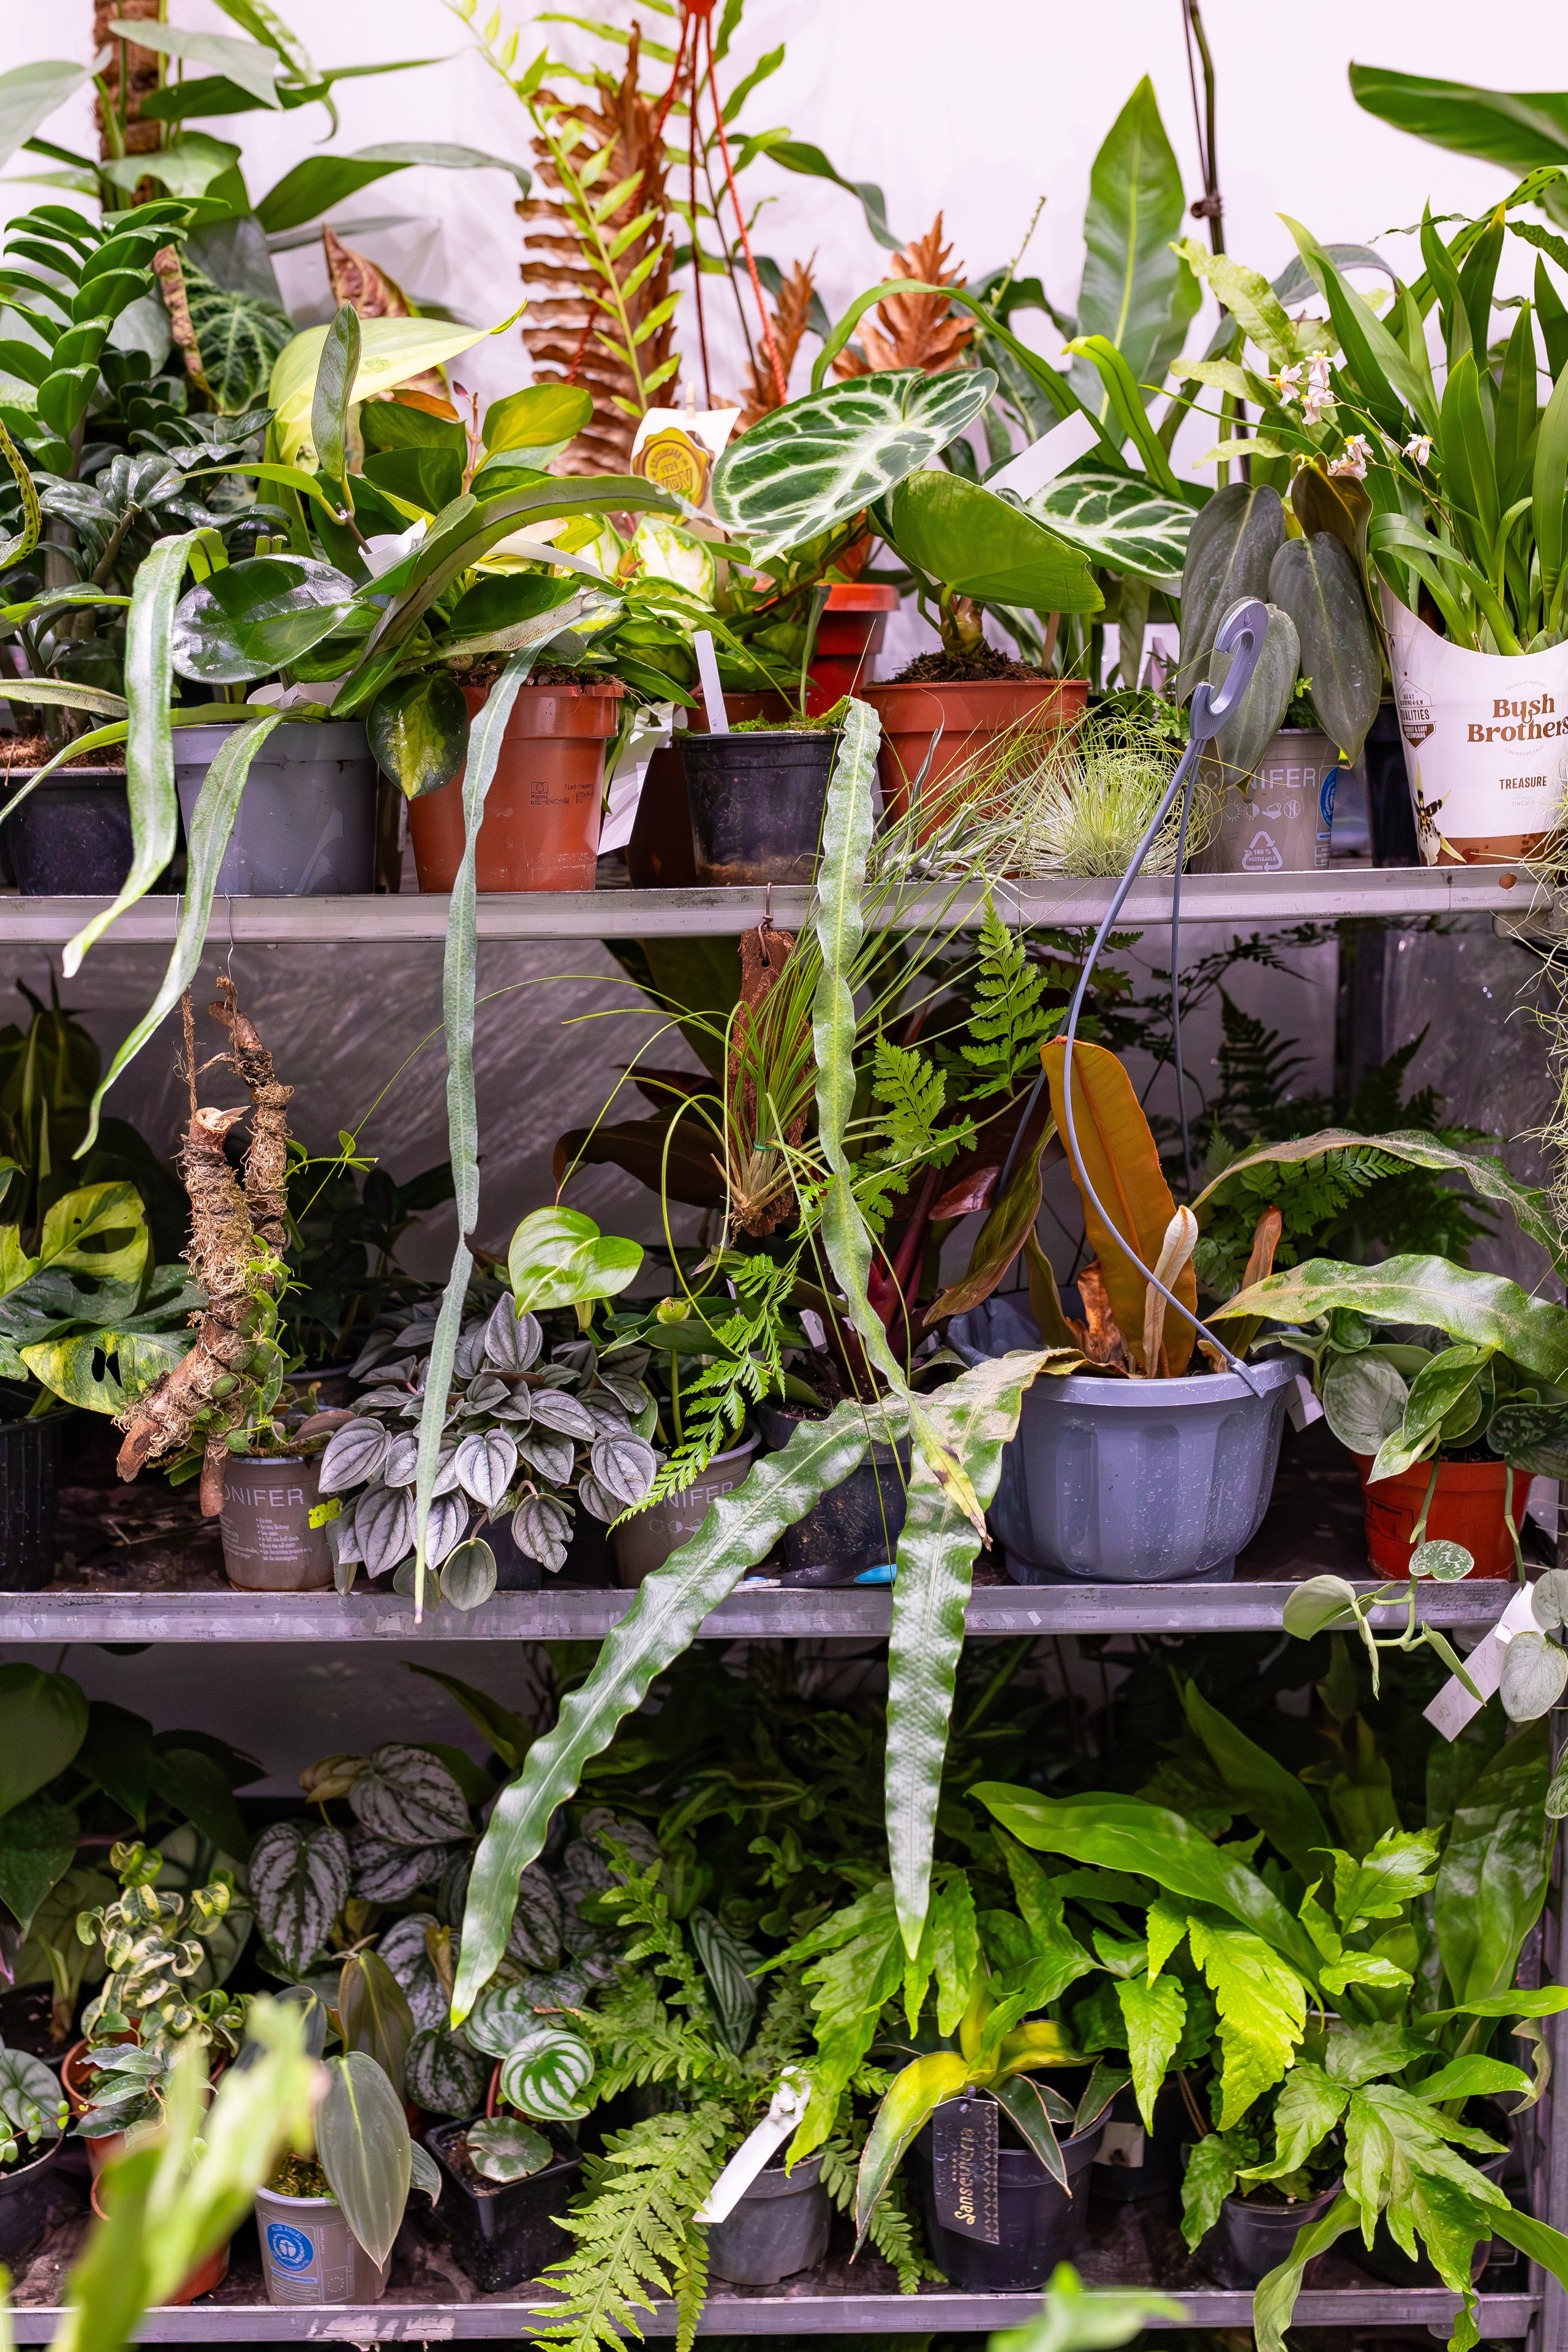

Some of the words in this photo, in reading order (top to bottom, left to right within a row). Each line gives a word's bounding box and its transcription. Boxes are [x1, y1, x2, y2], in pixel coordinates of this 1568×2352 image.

[1505, 680, 1528, 692] TREASURE
[1529, 680, 1547, 689] HUNTERS
[1400, 708, 1430, 721] UALITIES
[1493, 693, 1555, 724] Bush
[1467, 715, 1568, 742] Brothers
[1499, 775, 1547, 790] TREASURE
